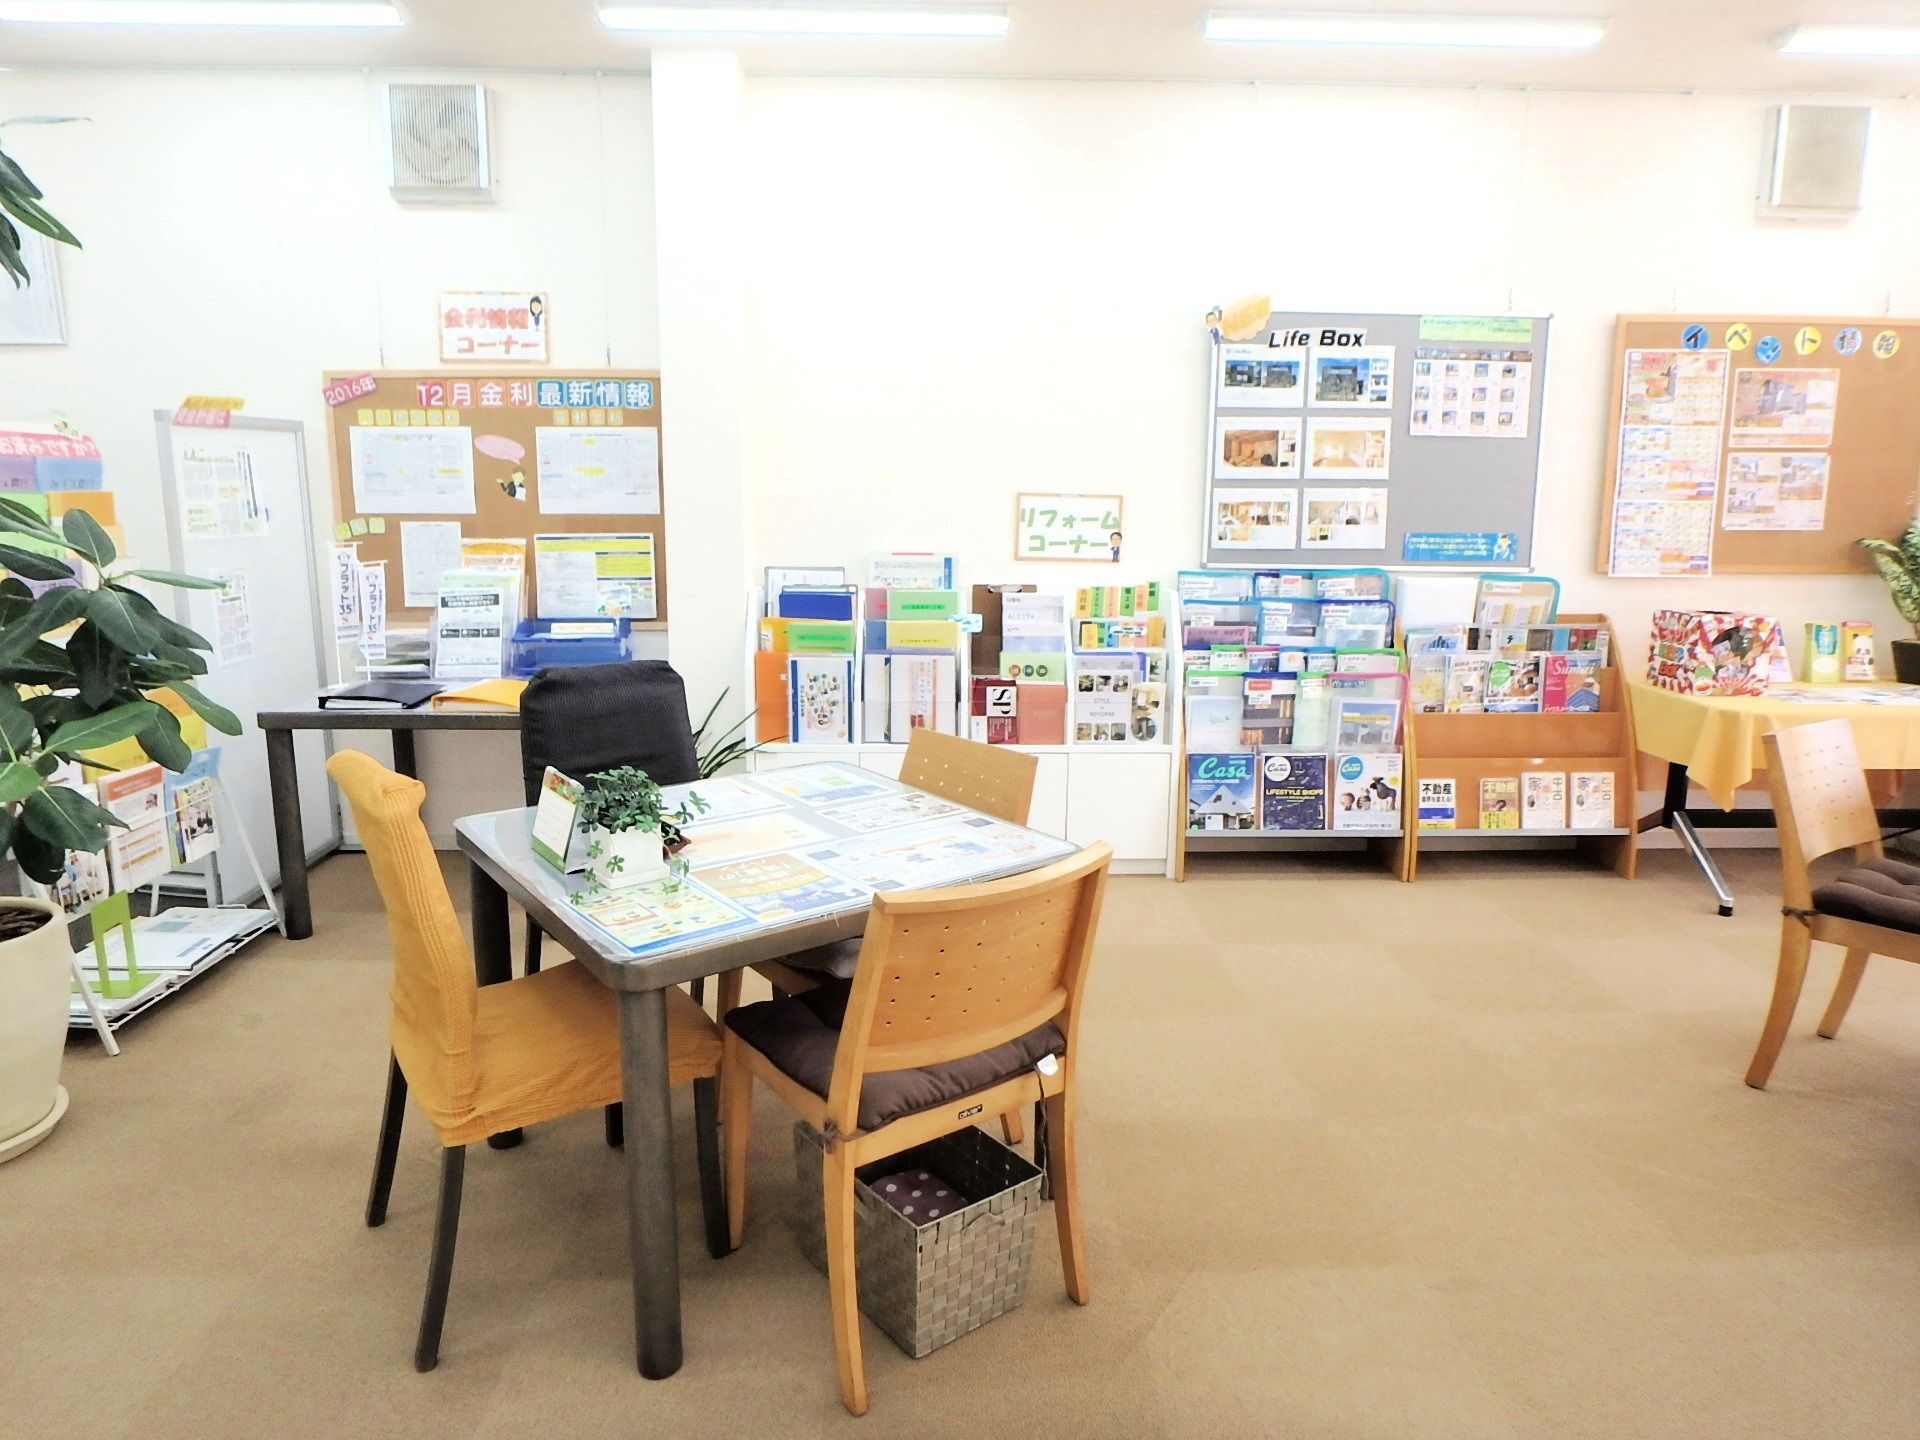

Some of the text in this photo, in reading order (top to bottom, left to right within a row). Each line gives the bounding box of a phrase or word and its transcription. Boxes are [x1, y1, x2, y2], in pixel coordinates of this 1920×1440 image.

[444, 307, 529, 330] 金利情報
[456, 335, 540, 355] コーナー
[1268, 328, 1364, 348] Life Box
[325, 375, 376, 406] 2016年
[416, 379, 652, 407] 12月金利最新情報
[1020, 508, 1120, 529] リフォーム
[1028, 534, 1109, 554] コーナー
[1198, 756, 1251, 780] Casa
[1422, 783, 1452, 796] 不動産
